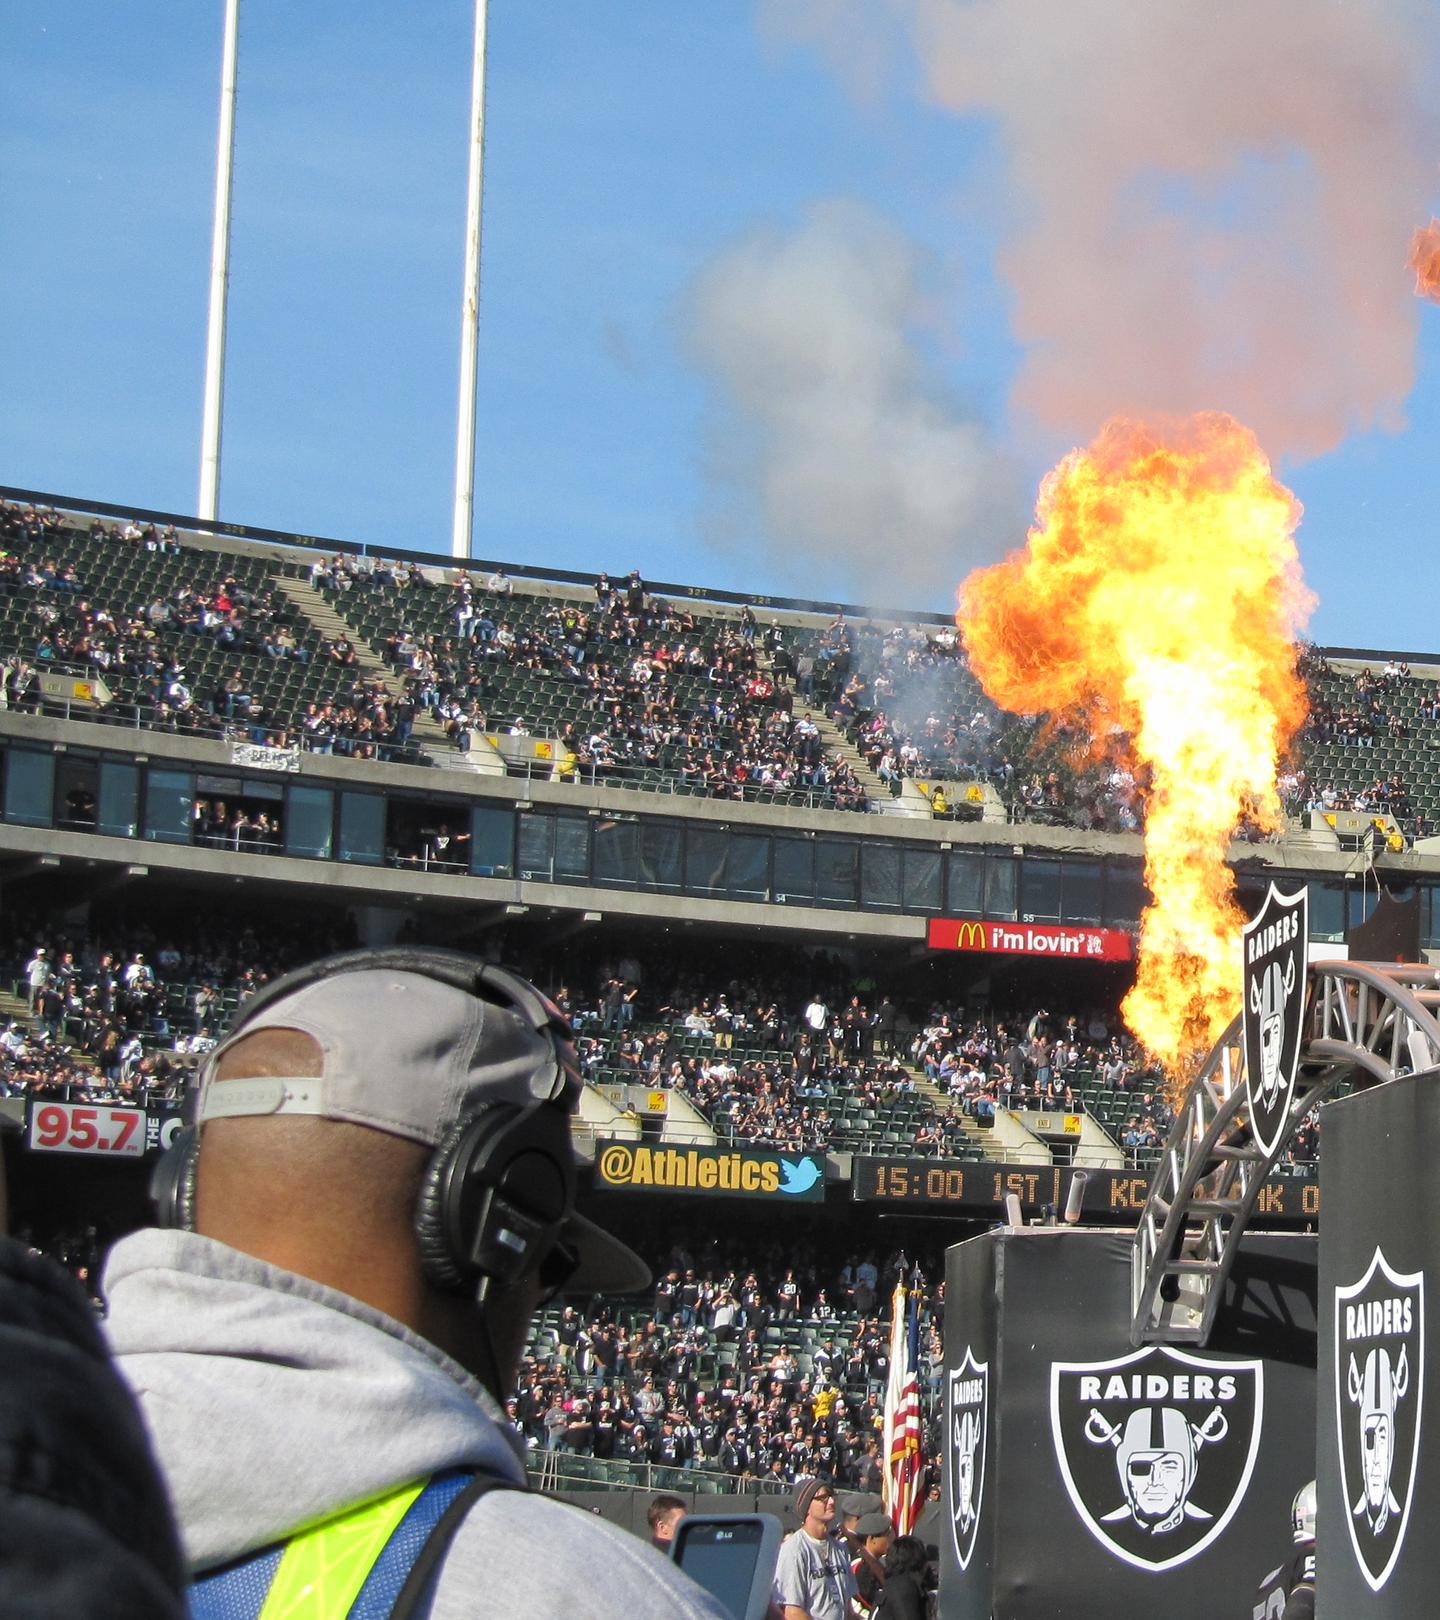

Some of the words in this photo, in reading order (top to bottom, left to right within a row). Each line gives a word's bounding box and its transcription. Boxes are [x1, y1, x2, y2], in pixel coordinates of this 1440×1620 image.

[992, 928, 1026, 950] i'm
[1027, 931, 1085, 954] lovin'
[1248, 910, 1298, 965] RAIDERS
[37, 1106, 139, 1150] 95.7
[147, 1117, 160, 1150] THE
[600, 1146, 779, 1192] @Athletics
[876, 1167, 963, 1199] 15:00
[993, 1172, 1040, 1203] 1ST
[1346, 1297, 1412, 1341] RAIDERS
[954, 1378, 983, 1406] RAIDERS
[1080, 1375, 1237, 1400] RAIDERS
